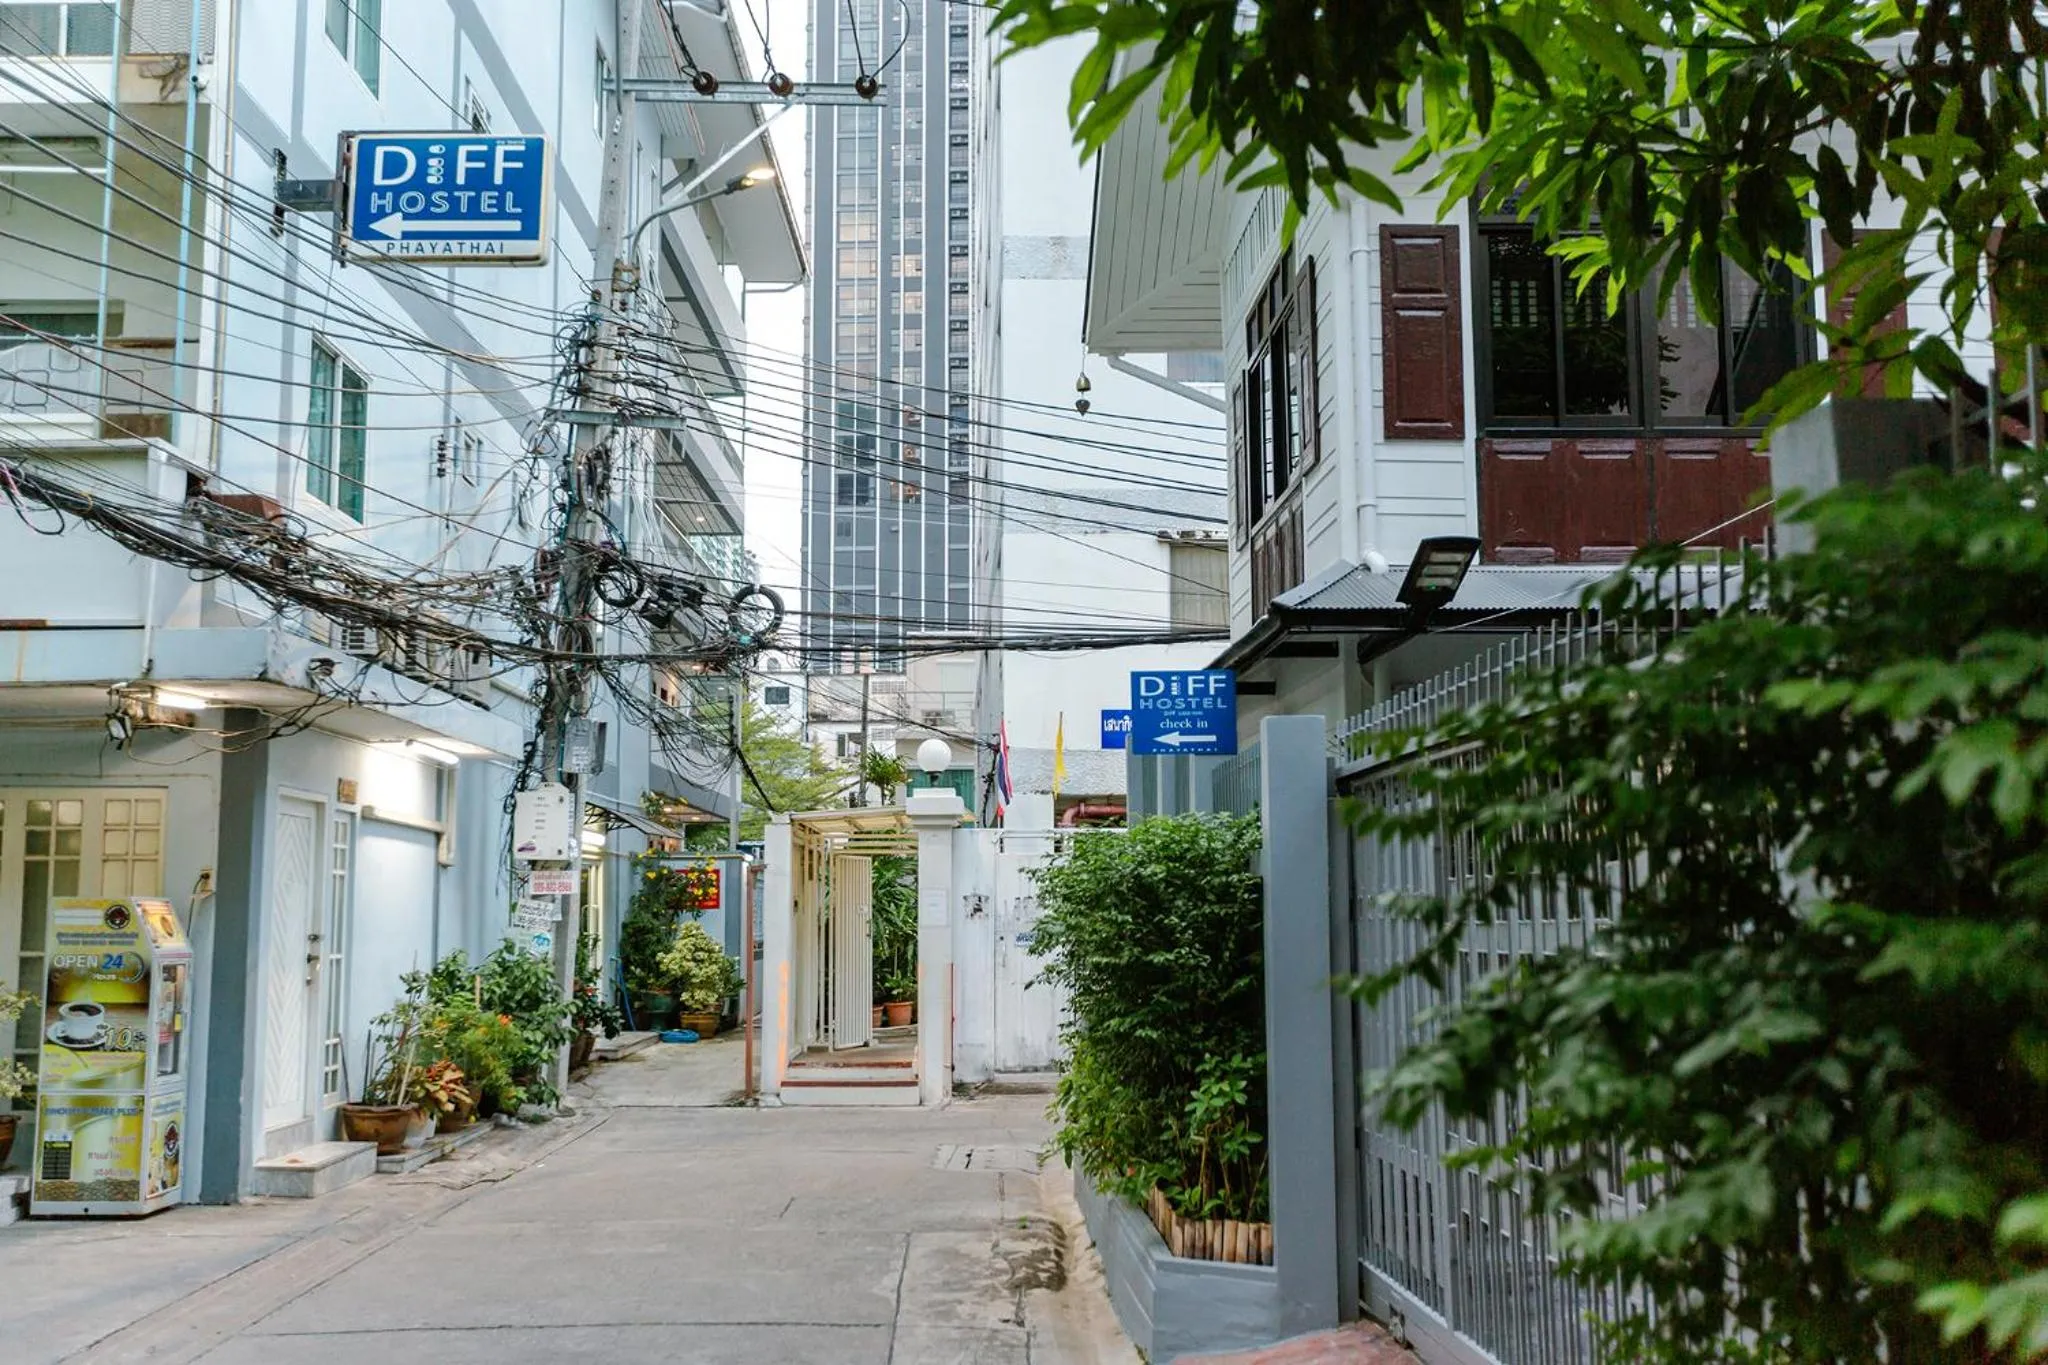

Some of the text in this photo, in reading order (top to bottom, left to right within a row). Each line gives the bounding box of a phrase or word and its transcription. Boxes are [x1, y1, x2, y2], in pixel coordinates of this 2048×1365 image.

[370, 191, 523, 214] HOSTEL
[386, 242, 505, 255] PHAYATHAI
[1139, 675, 1227, 696] DiFF
[1139, 698, 1228, 710] HOSTEL
[1159, 718, 1208, 729] check in
[54, 953, 124, 970] OPEN 24
